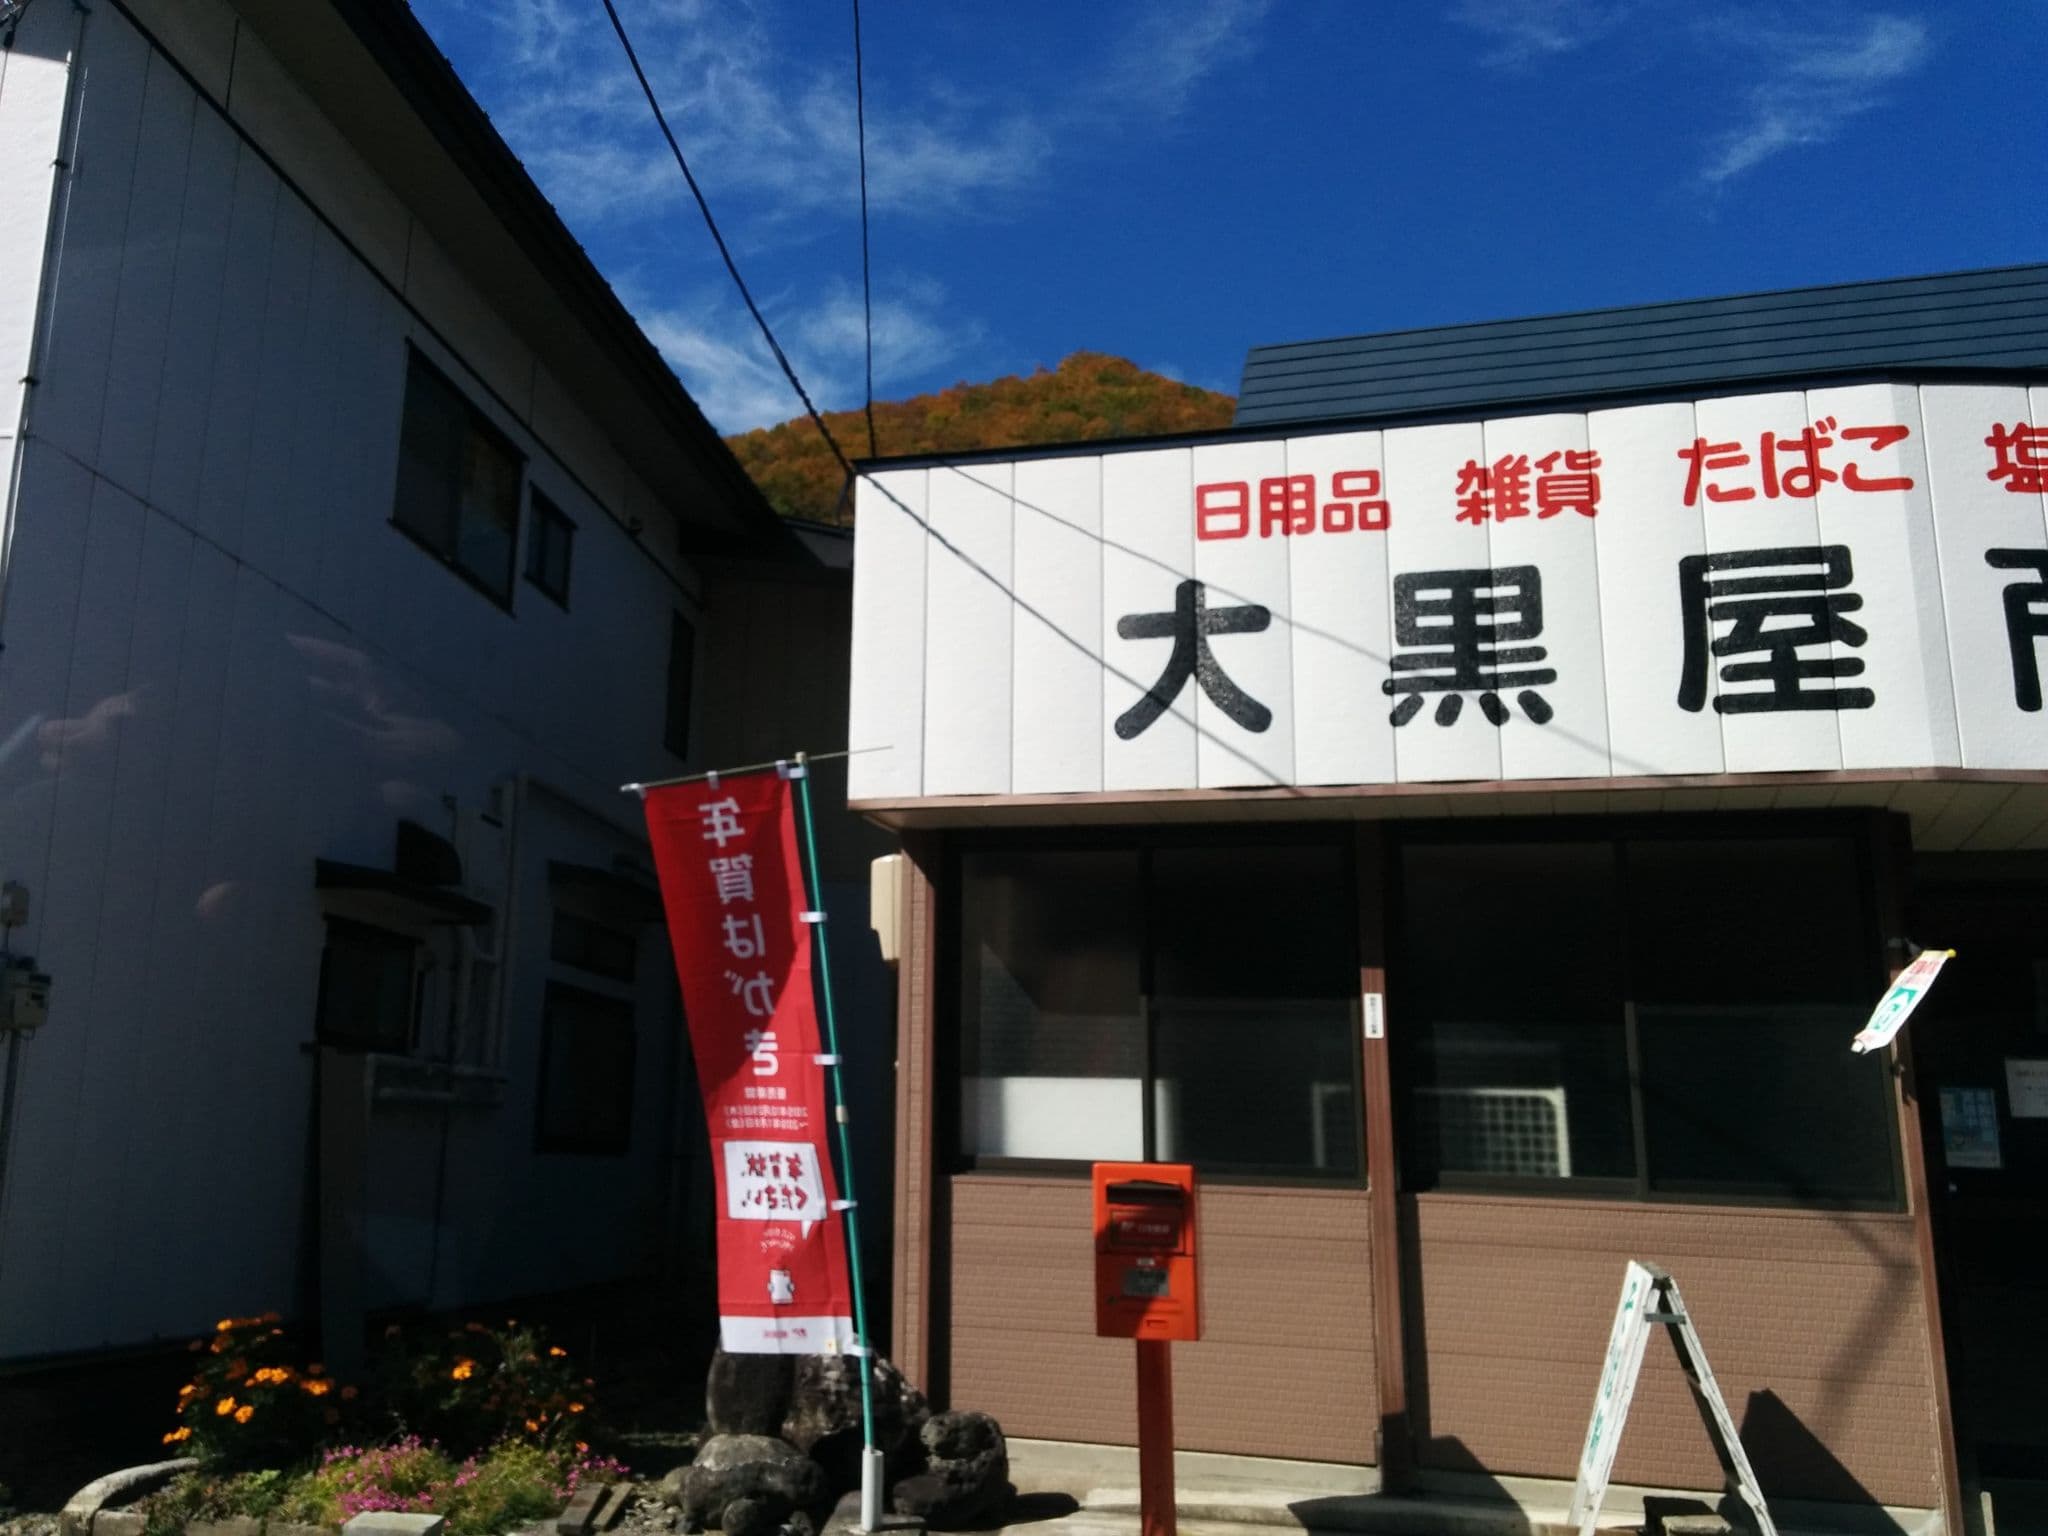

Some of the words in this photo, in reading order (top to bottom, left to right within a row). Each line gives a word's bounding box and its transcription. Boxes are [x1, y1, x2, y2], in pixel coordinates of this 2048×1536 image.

[1196, 469, 1391, 541] 日用品
[1455, 448, 1602, 526] 雑貨
[1677, 415, 1914, 507] たばこ
